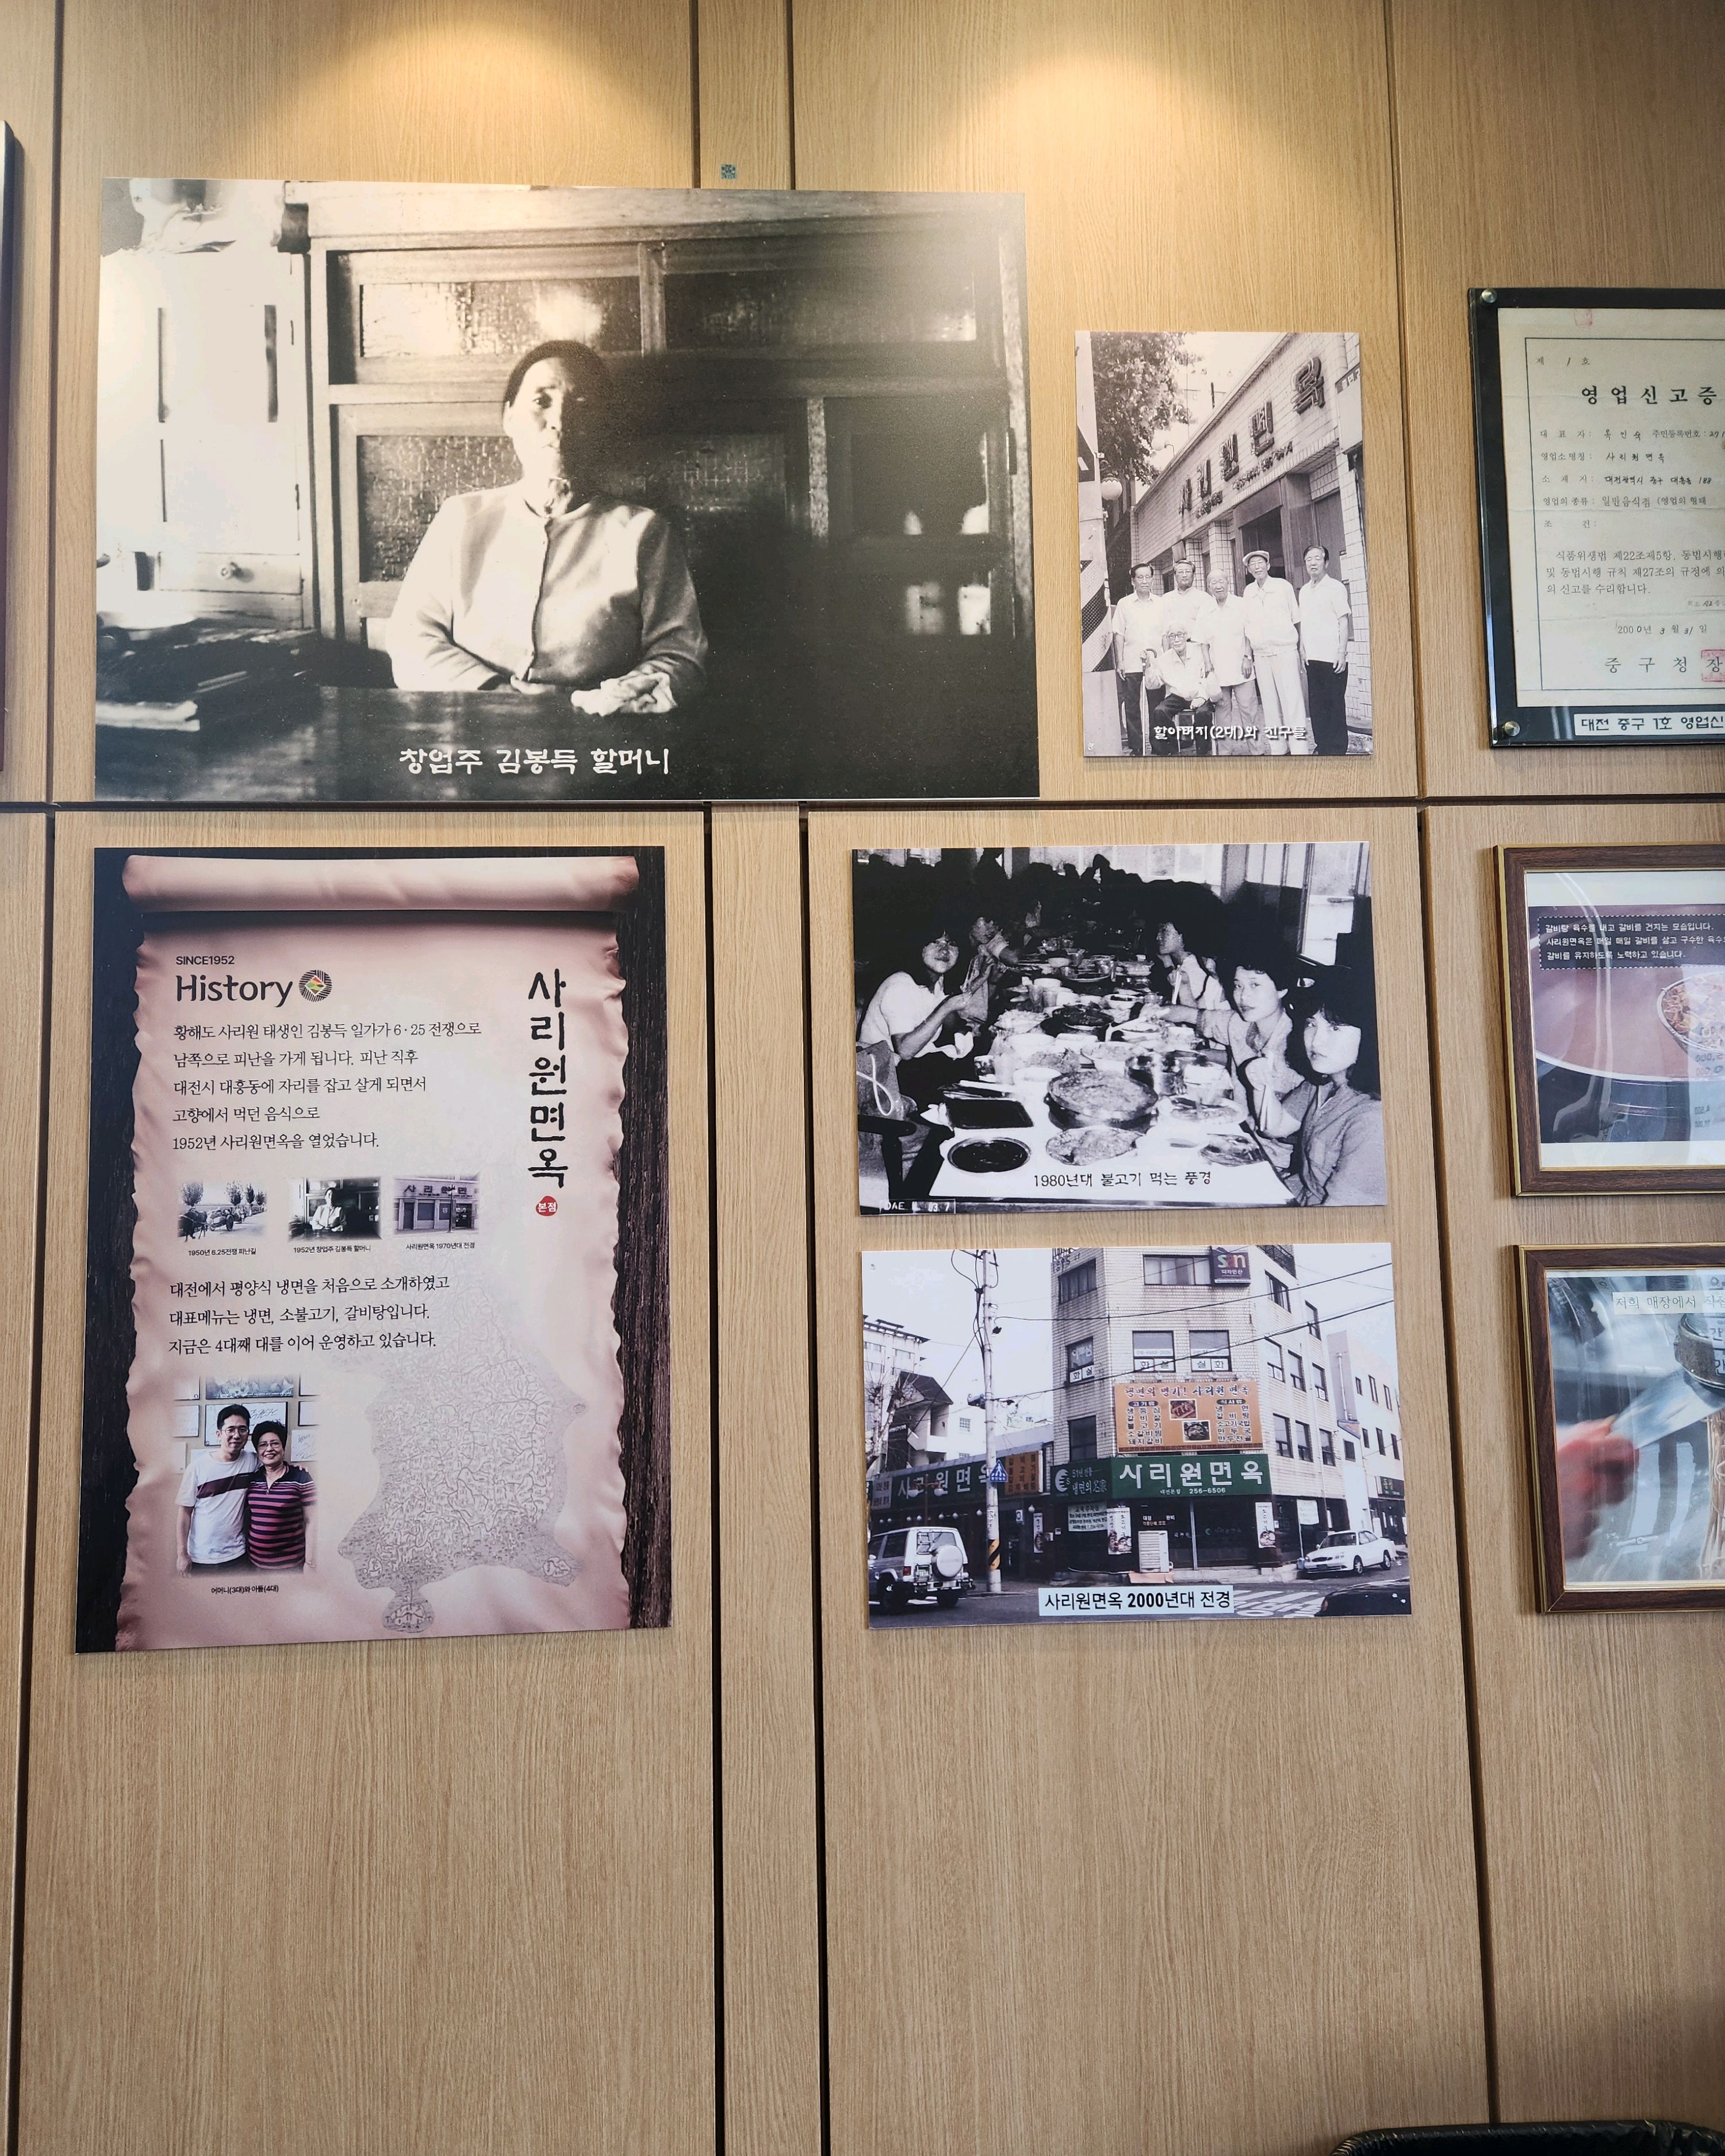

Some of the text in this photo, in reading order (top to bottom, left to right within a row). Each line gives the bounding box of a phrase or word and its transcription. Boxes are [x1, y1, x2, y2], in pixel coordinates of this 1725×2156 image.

[1581, 385, 1717, 405] 영업신고증
[1543, 497, 1567, 506] 영업의
[1602, 496, 1650, 507] 일반음식점
[1555, 550, 1725, 562] 식품위생법 동법시행
[1546, 567, 1555, 577] 및
[1561, 567, 1601, 578] 동법시행
[1607, 567, 1626, 577] 규칙
[1632, 566, 1674, 577] 제27조의
[1680, 566, 1709, 577] 규정에
[1547, 583, 1650, 594] 의 신고를 수리합니다.
[1581, 718, 1609, 731] 대전
[1617, 718, 1645, 731] 중구
[1653, 717, 1672, 730] 1호
[1153, 725, 1306, 740] 할아버지(2대)와 친구들
[399, 748, 669, 774] 창업주 김봉득 할머니
[1546, 922, 1714, 933] 갈비탕 육수를 내고 갈비를 건지는 모습입니다.
[1546, 938, 1592, 946] 사리원면옥은
[1597, 937, 1612, 946] 매일
[1616, 937, 1631, 945] 매일
[1635, 937, 1658, 945] 갈비를
[1662, 936, 1677, 945] 삶고
[1681, 936, 1703, 944] 구수한
[176, 956, 235, 965] SINCE1952
[1547, 950, 1685, 960] 갈비를 유지하도록 노력하고 있습니다.
[176, 975, 293, 1007] History
[174, 1025, 215, 1040] 황해도
[218, 1025, 259, 1039] 사리원
[263, 1024, 302, 1039] 태생인
[308, 1024, 347, 1038] 김봉득
[351, 1023, 390, 1037] 일가가
[428, 1022, 482, 1037] 전쟁으로
[174, 1049, 418, 1067] 남쪽으로 피난을 가게 됩니다. 피난 직후
[174, 1077, 426, 1095] 대전시 대흥동에 자리를 잡고 살게 되면서
[528, 968, 568, 1188] 사리원면옥
[172, 1106, 320, 1122] 고향에서 먹던 음식으로
[172, 1132, 379, 1150] 1952년 사리원면옥을 열었습니다.
[1033, 1171, 1211, 1187] 1980년대 불고기 먹는 풍경
[538, 1202, 557, 1212] 본점
[238, 1247, 256, 1255] 피난길
[171, 1276, 450, 1298] 대전에서 평양식 냉면을 처음으로 소개하였고
[1616, 1295, 1696, 1309] 저희 매장에서
[170, 1304, 430, 1326] 대표메뉴는 냉면, 소불고기, 갈비탕입니다.
[168, 1332, 436, 1355] 지금은 4대째 대를 이어 운영하고 있습니다.
[1119, 1461, 1263, 1489] 사리원면옥
[211, 1585, 278, 1595] 어머니(3대)와 아들(4대)
[1045, 1590, 1230, 1610] 사리원면옥 2000년대 전경
